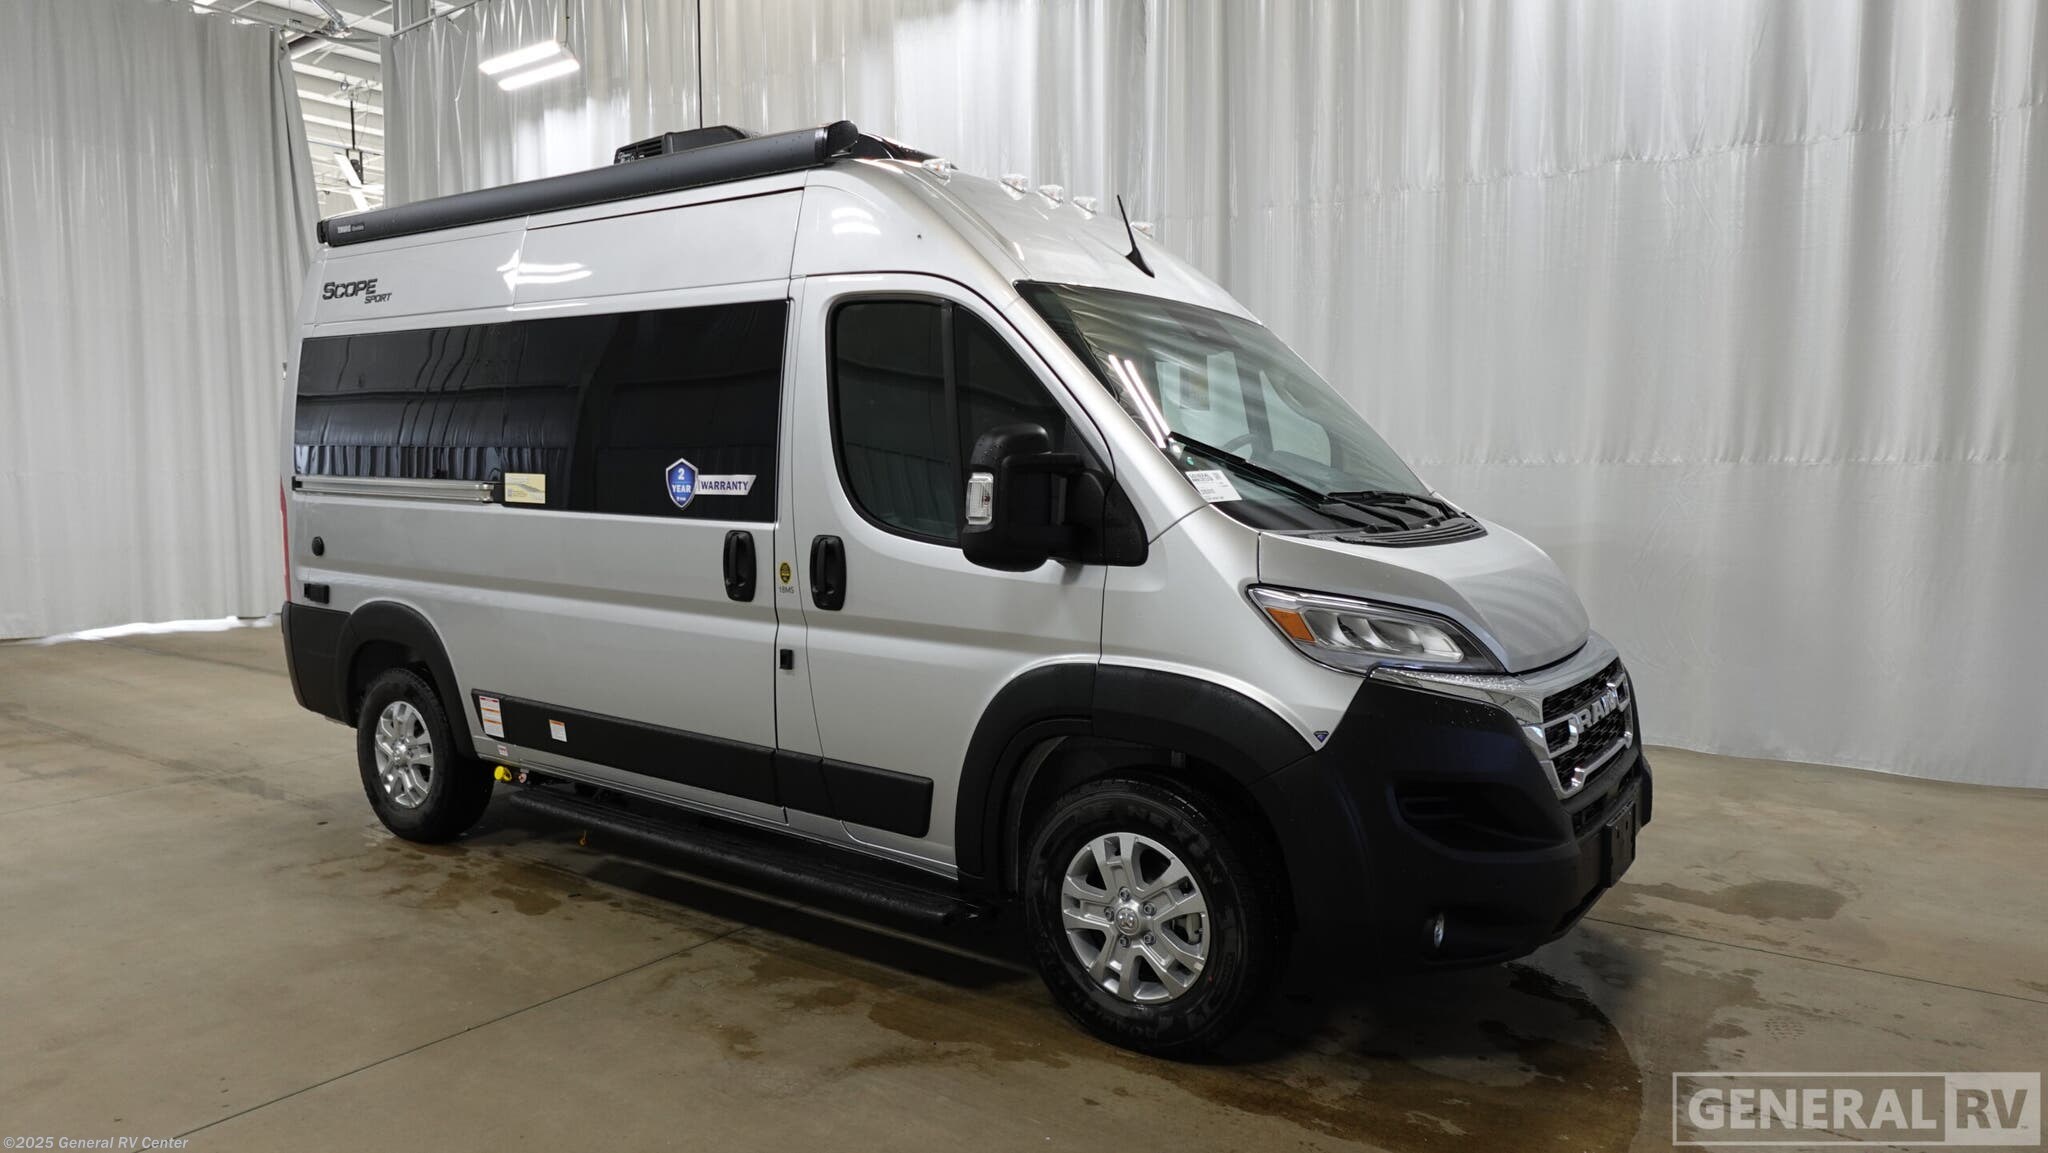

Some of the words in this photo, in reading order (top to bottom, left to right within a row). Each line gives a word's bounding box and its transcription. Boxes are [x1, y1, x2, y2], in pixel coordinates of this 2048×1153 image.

[322, 278, 378, 300] SCOPE
[364, 292, 393, 304] SPORT
[677, 467, 686, 481] 2
[671, 484, 692, 493] YEAR
[701, 480, 749, 491] WARRANTY
[1577, 687, 1620, 734] RAM
